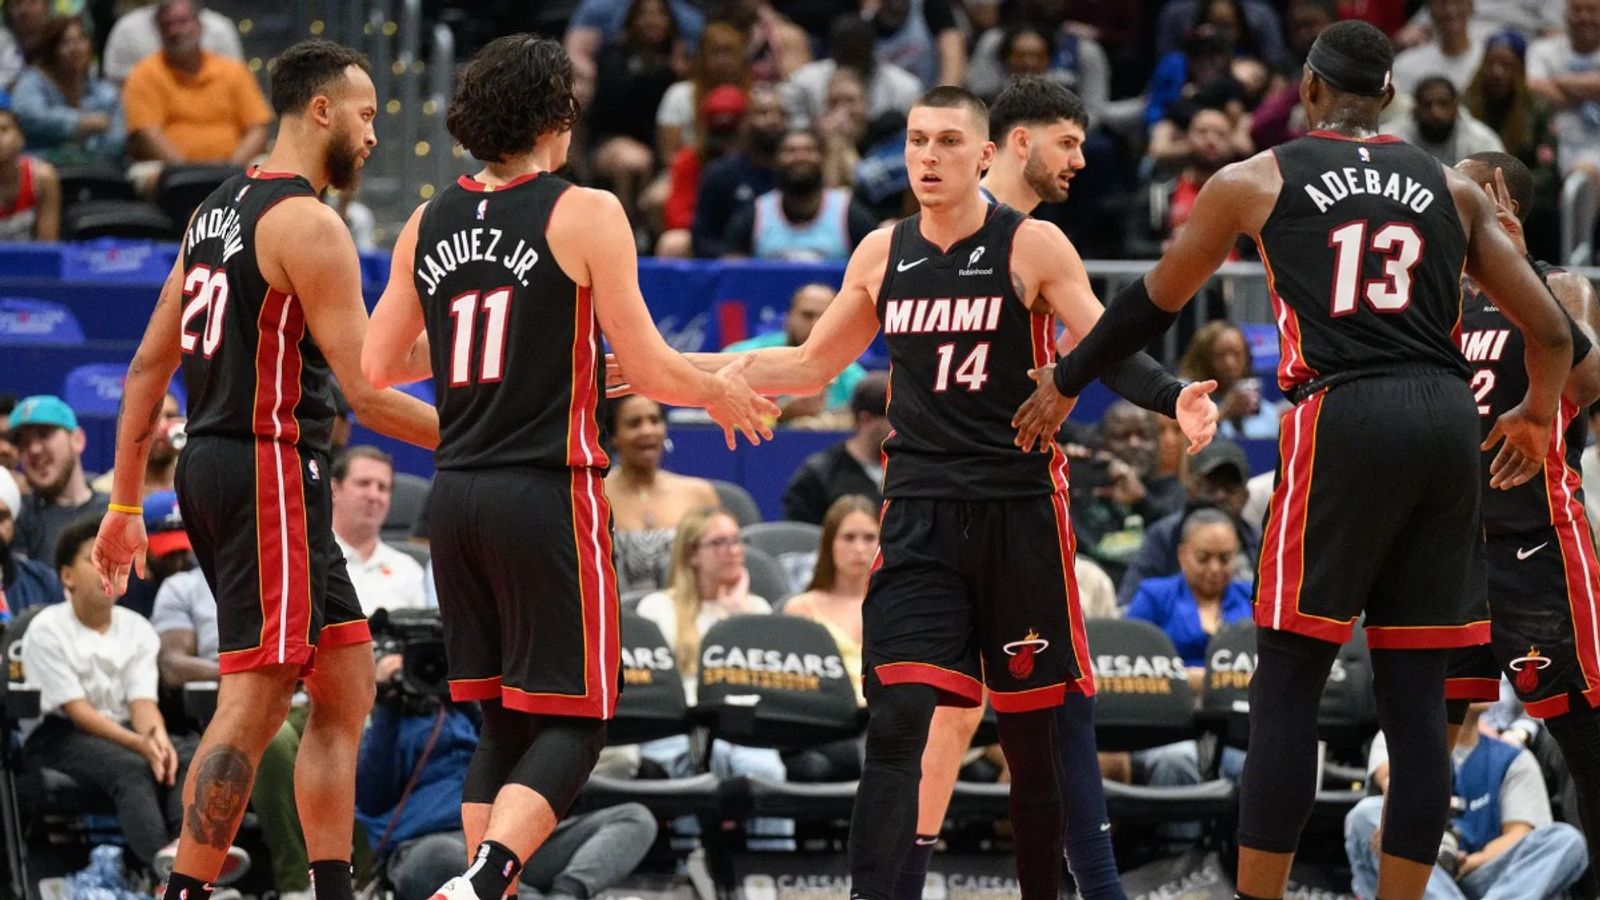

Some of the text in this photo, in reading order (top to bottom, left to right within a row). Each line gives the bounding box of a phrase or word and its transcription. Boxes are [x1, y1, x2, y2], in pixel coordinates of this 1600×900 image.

[1304, 167, 1434, 214] ADEBAYO
[417, 228, 539, 296] JAQUEZ JR.
[958, 268, 993, 276] Robinhood
[1327, 219, 1425, 319] 13
[180, 262, 229, 360] 20
[884, 296, 1004, 334] MIAMI
[449, 286, 514, 388] 11
[934, 341, 991, 393] 14
[1469, 368, 1496, 415] 2
[702, 645, 844, 679] CAESARS
[1211, 649, 1258, 673] CA
